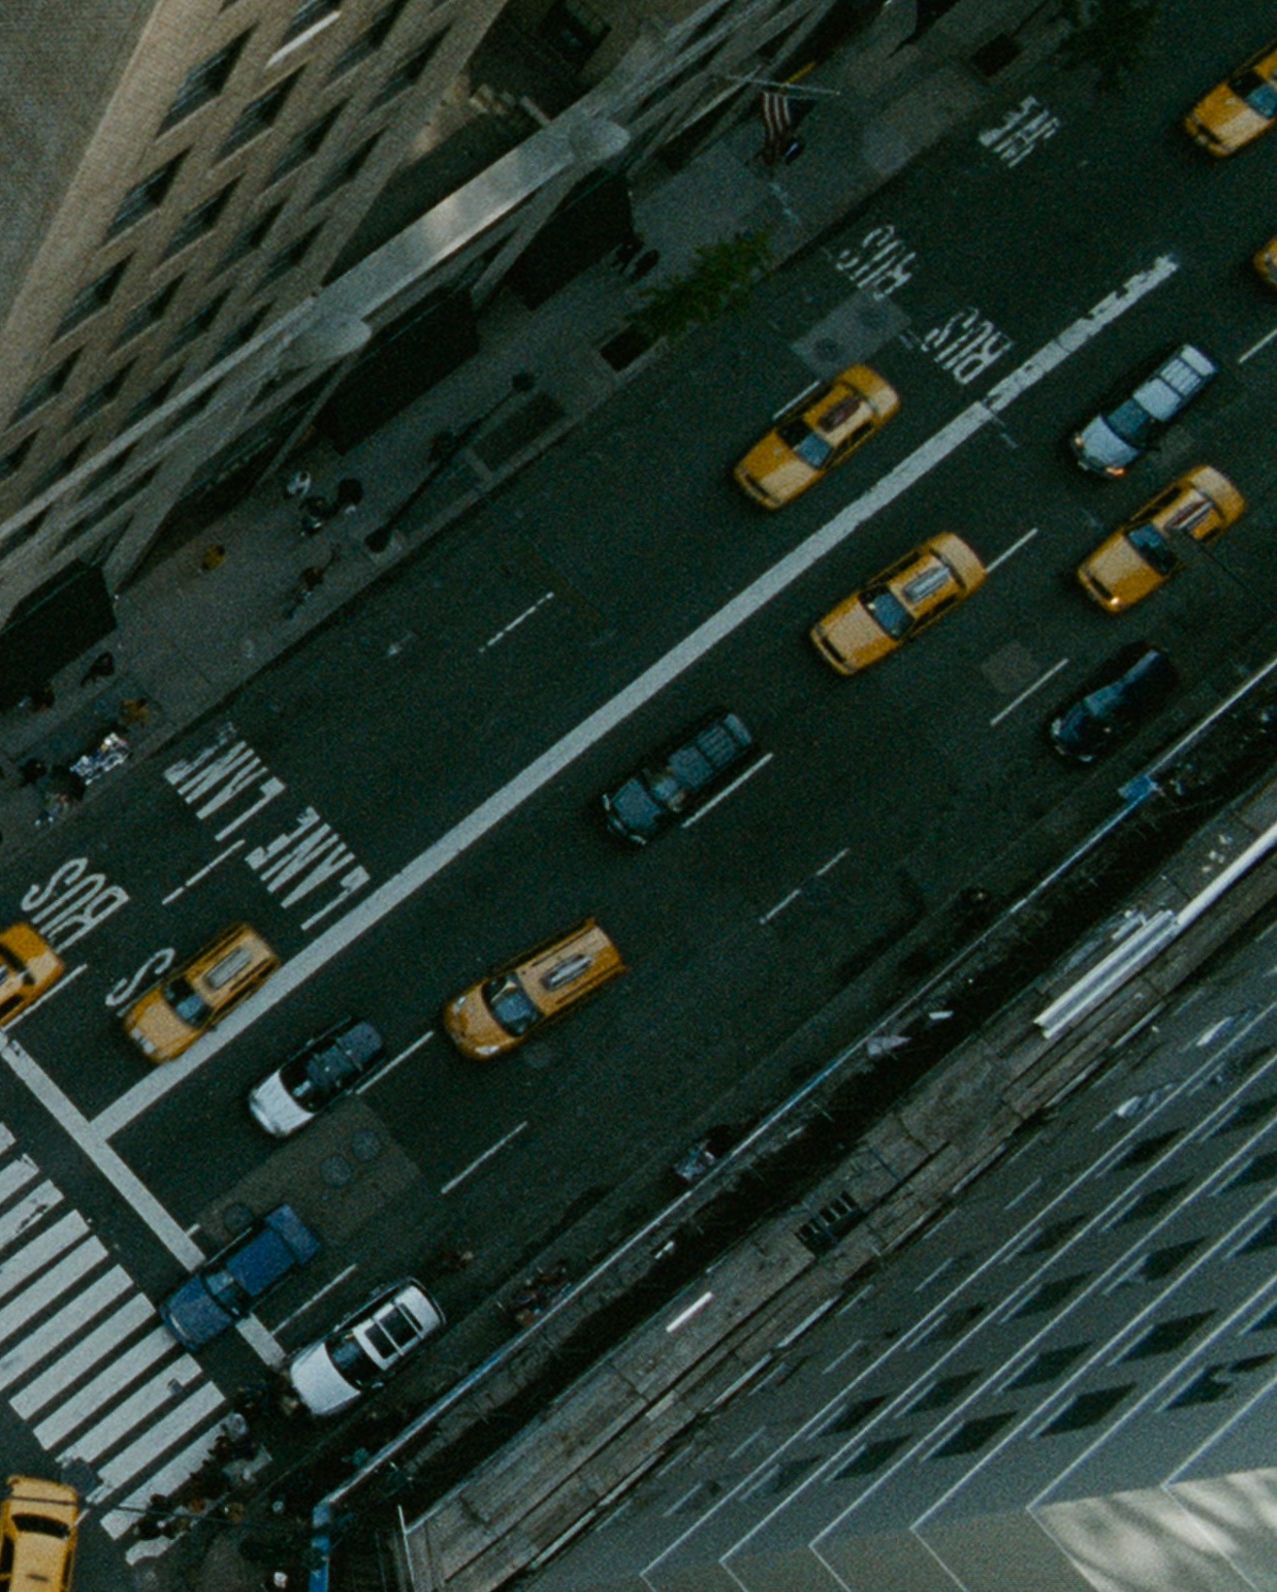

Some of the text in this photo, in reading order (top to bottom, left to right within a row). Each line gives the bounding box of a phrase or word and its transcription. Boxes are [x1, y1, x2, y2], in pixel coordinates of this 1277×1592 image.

[836, 225, 916, 300] BUS
[921, 306, 1014, 385] BUS
[164, 721, 285, 841] LANE
[21, 857, 129, 955] BUS
[245, 806, 370, 931] LANE
